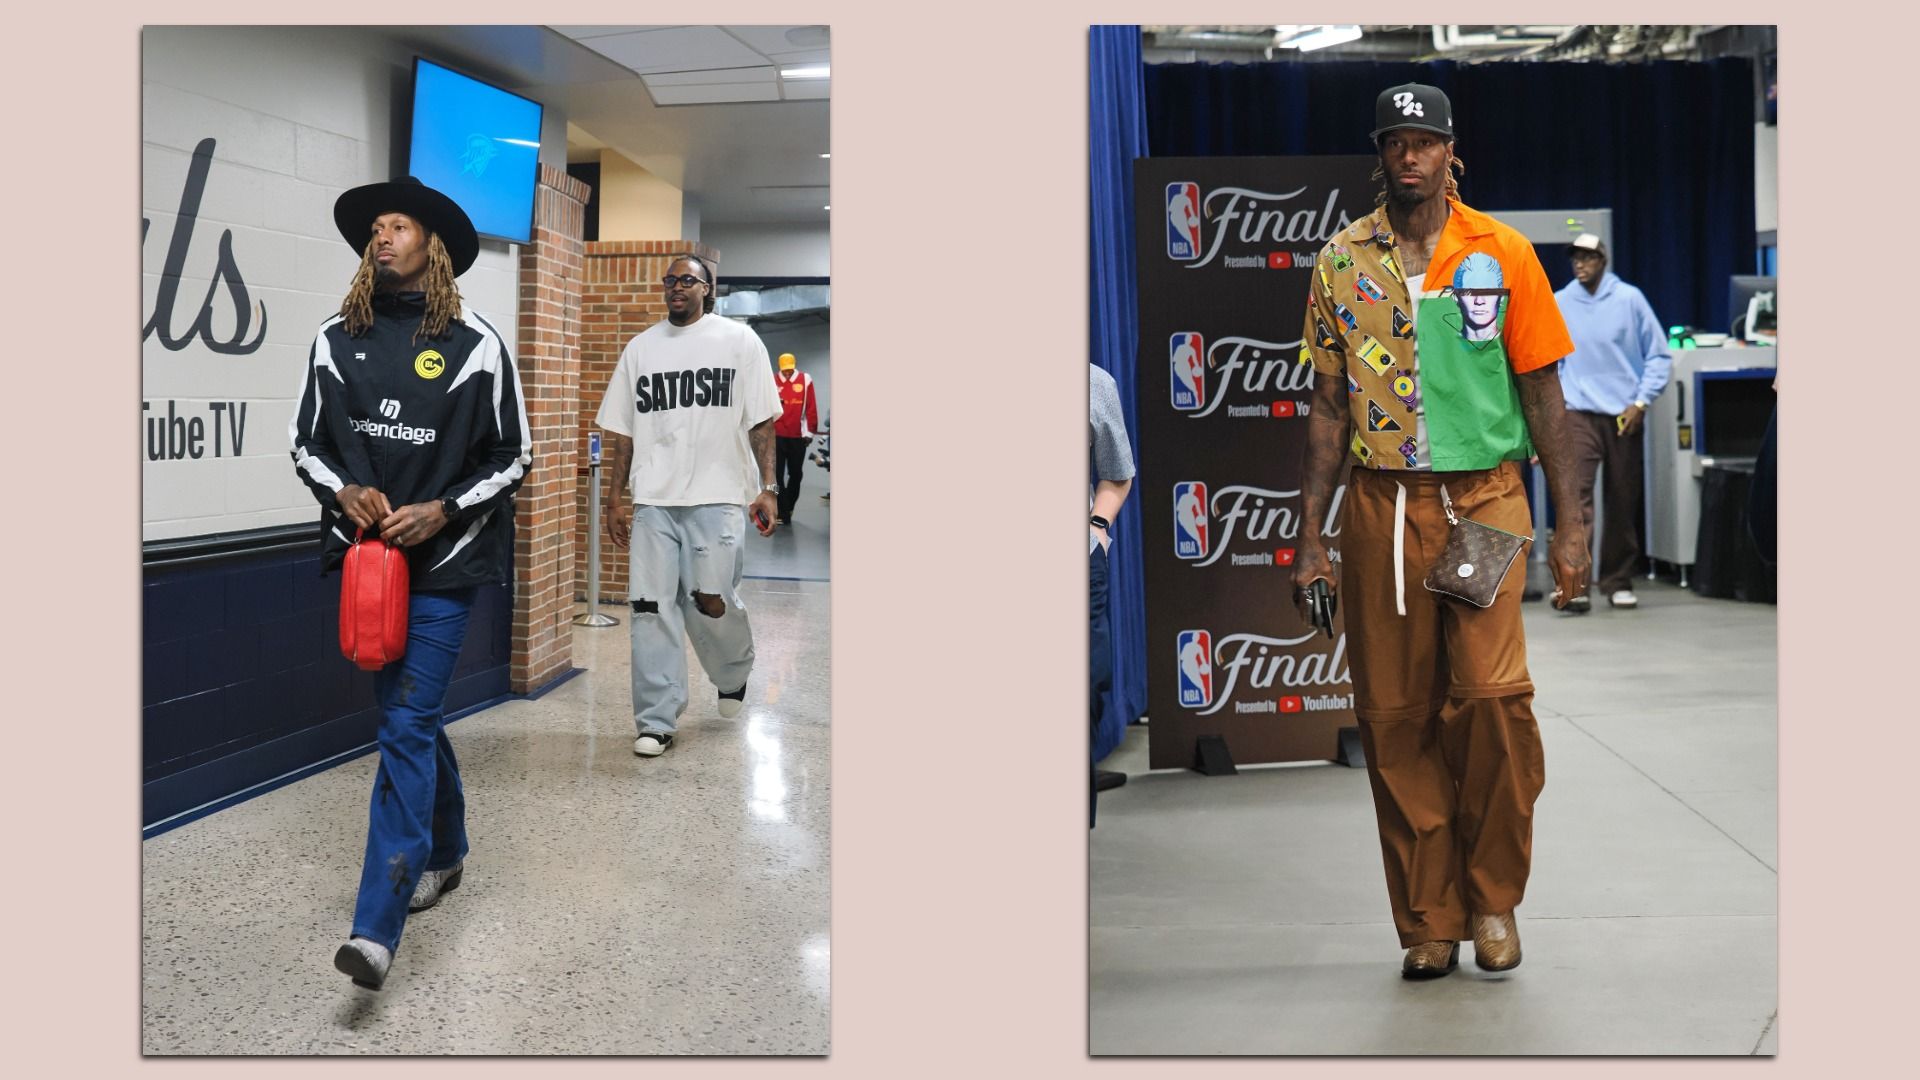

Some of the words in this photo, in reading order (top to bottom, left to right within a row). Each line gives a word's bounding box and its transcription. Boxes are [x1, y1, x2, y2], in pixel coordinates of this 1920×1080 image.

[143, 138, 267, 355] ls
[1172, 242, 1189, 255] NBA
[1176, 391, 1193, 404] NBA
[143, 400, 204, 461] ube
[209, 401, 247, 458] TV
[1180, 540, 1197, 554] NBA
[1195, 629, 1352, 716] Final
[1183, 689, 1200, 702] NBA
[1302, 693, 1347, 711] YouTube
